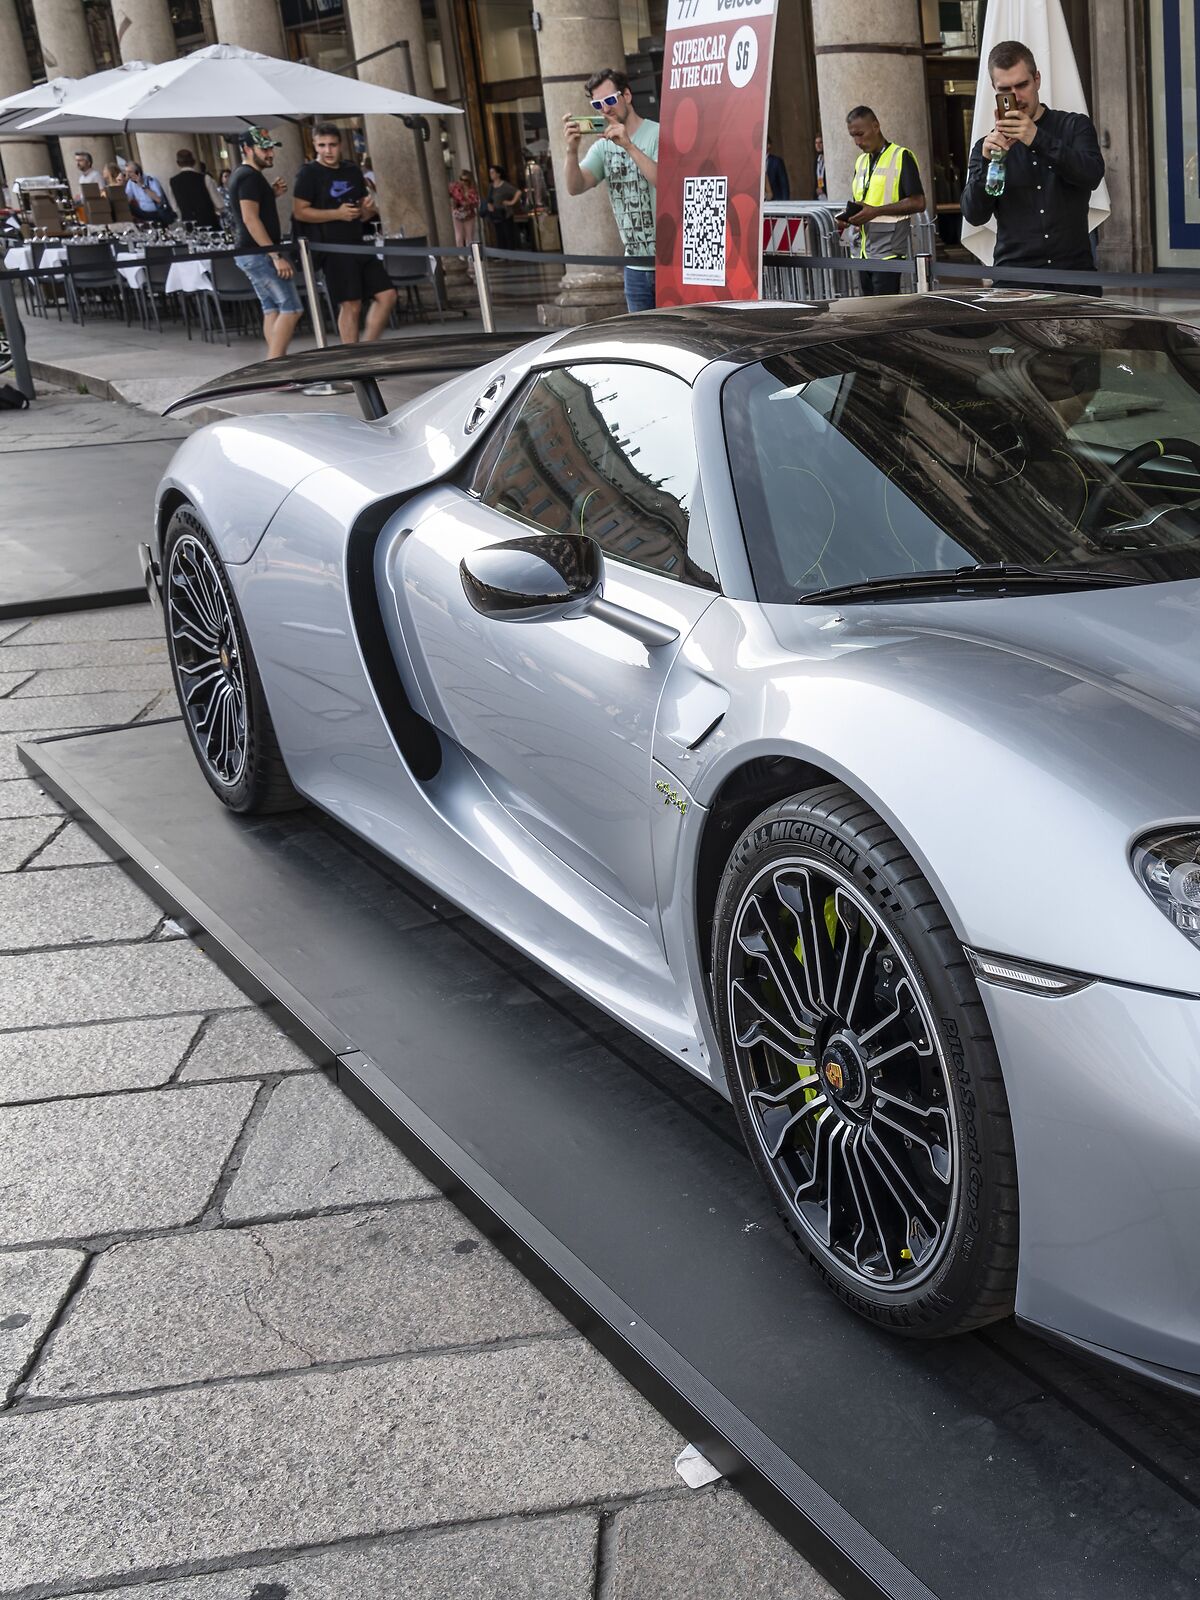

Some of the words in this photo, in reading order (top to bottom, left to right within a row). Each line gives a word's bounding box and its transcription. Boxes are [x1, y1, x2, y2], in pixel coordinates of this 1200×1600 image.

[672, 34, 726, 66] SUPERCAR
[736, 41, 750, 71] S6
[670, 68, 682, 90] IN
[682, 65, 700, 88] THE
[700, 62, 724, 86] CITY
[771, 821, 859, 868] MICHELIN
[941, 1018, 971, 1085] Pilot
[960, 1087, 982, 1164] Sport
[967, 1166, 983, 1210] Cup
[967, 1211, 980, 1233] 2
